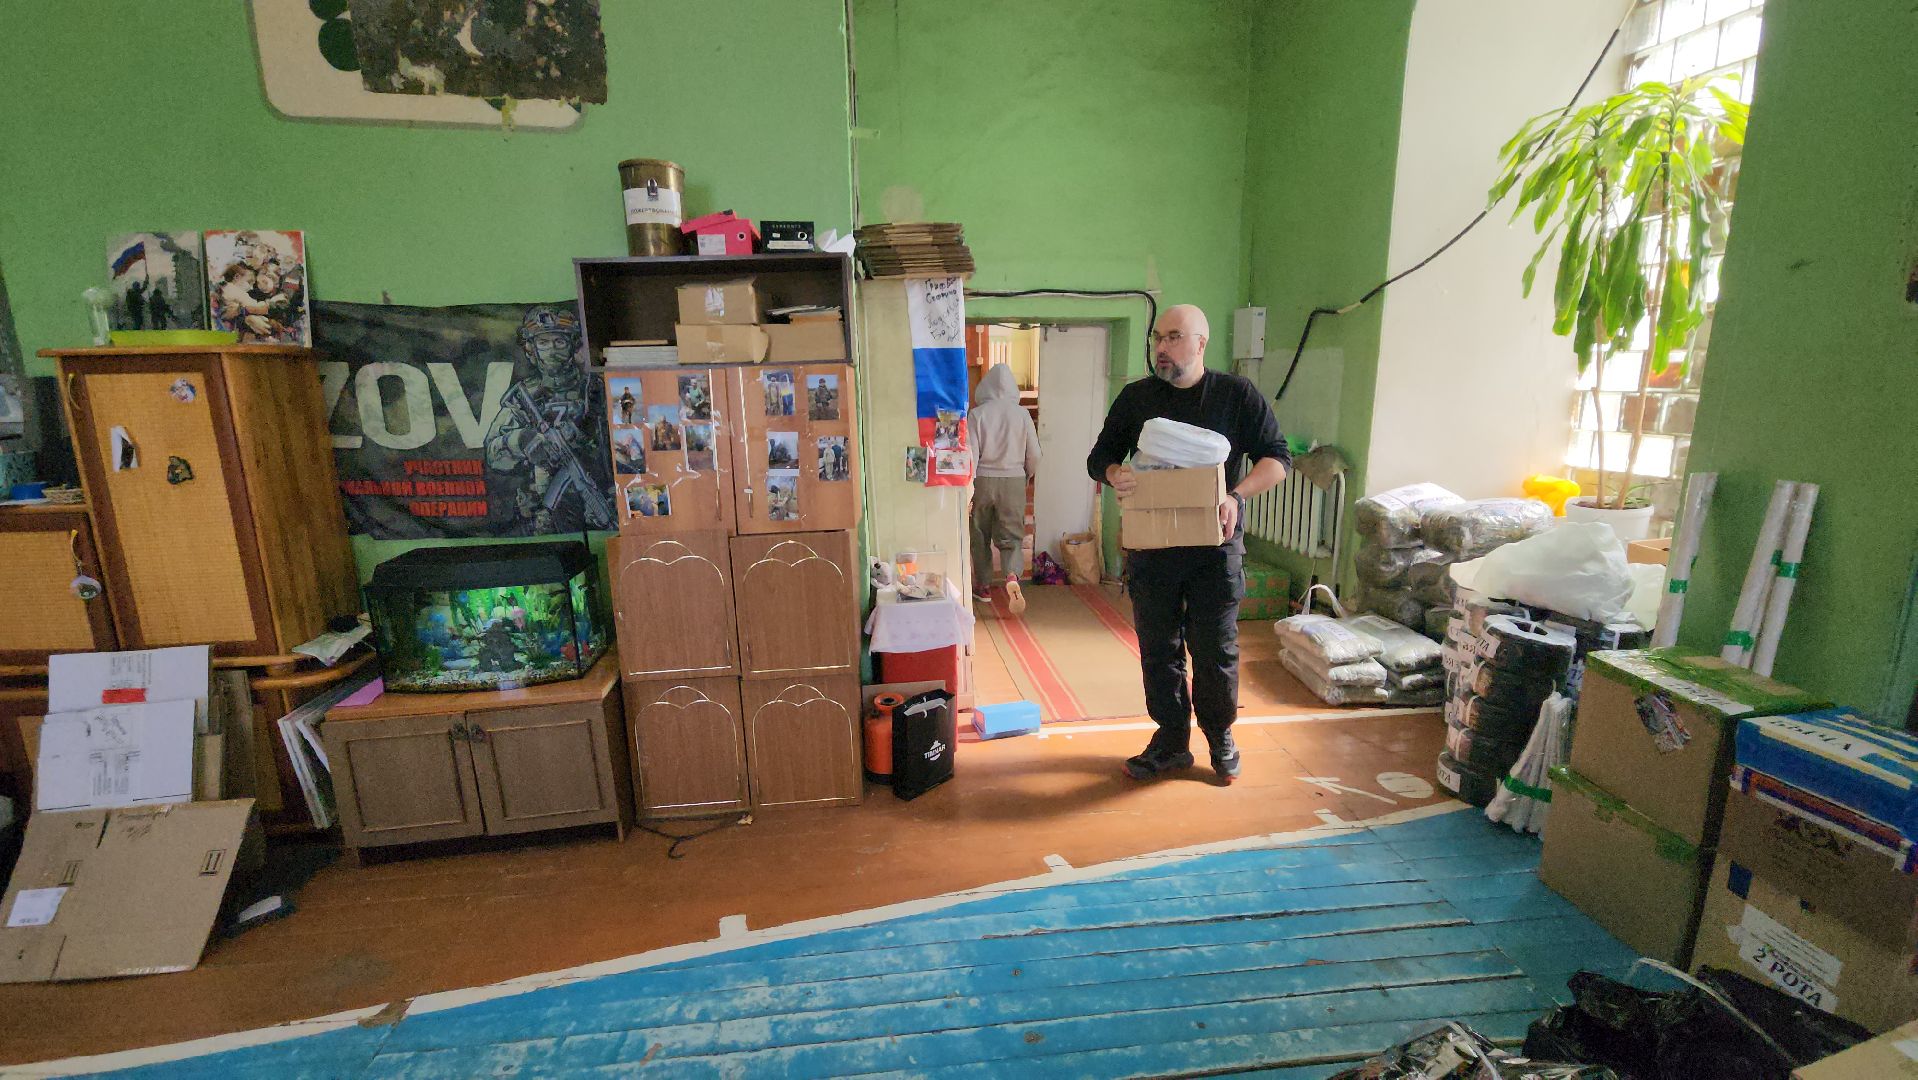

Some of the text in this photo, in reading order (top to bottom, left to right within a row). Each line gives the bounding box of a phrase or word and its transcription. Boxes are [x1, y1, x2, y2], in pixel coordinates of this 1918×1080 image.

[403, 459, 485, 476] УЧАСТНИК
[415, 480, 486, 497] ВОЕННОЙ
[409, 501, 489, 517] ОПЕРАЦИИ
[1752, 947, 1767, 964] 2
[1768, 960, 1823, 1007] РОТА
